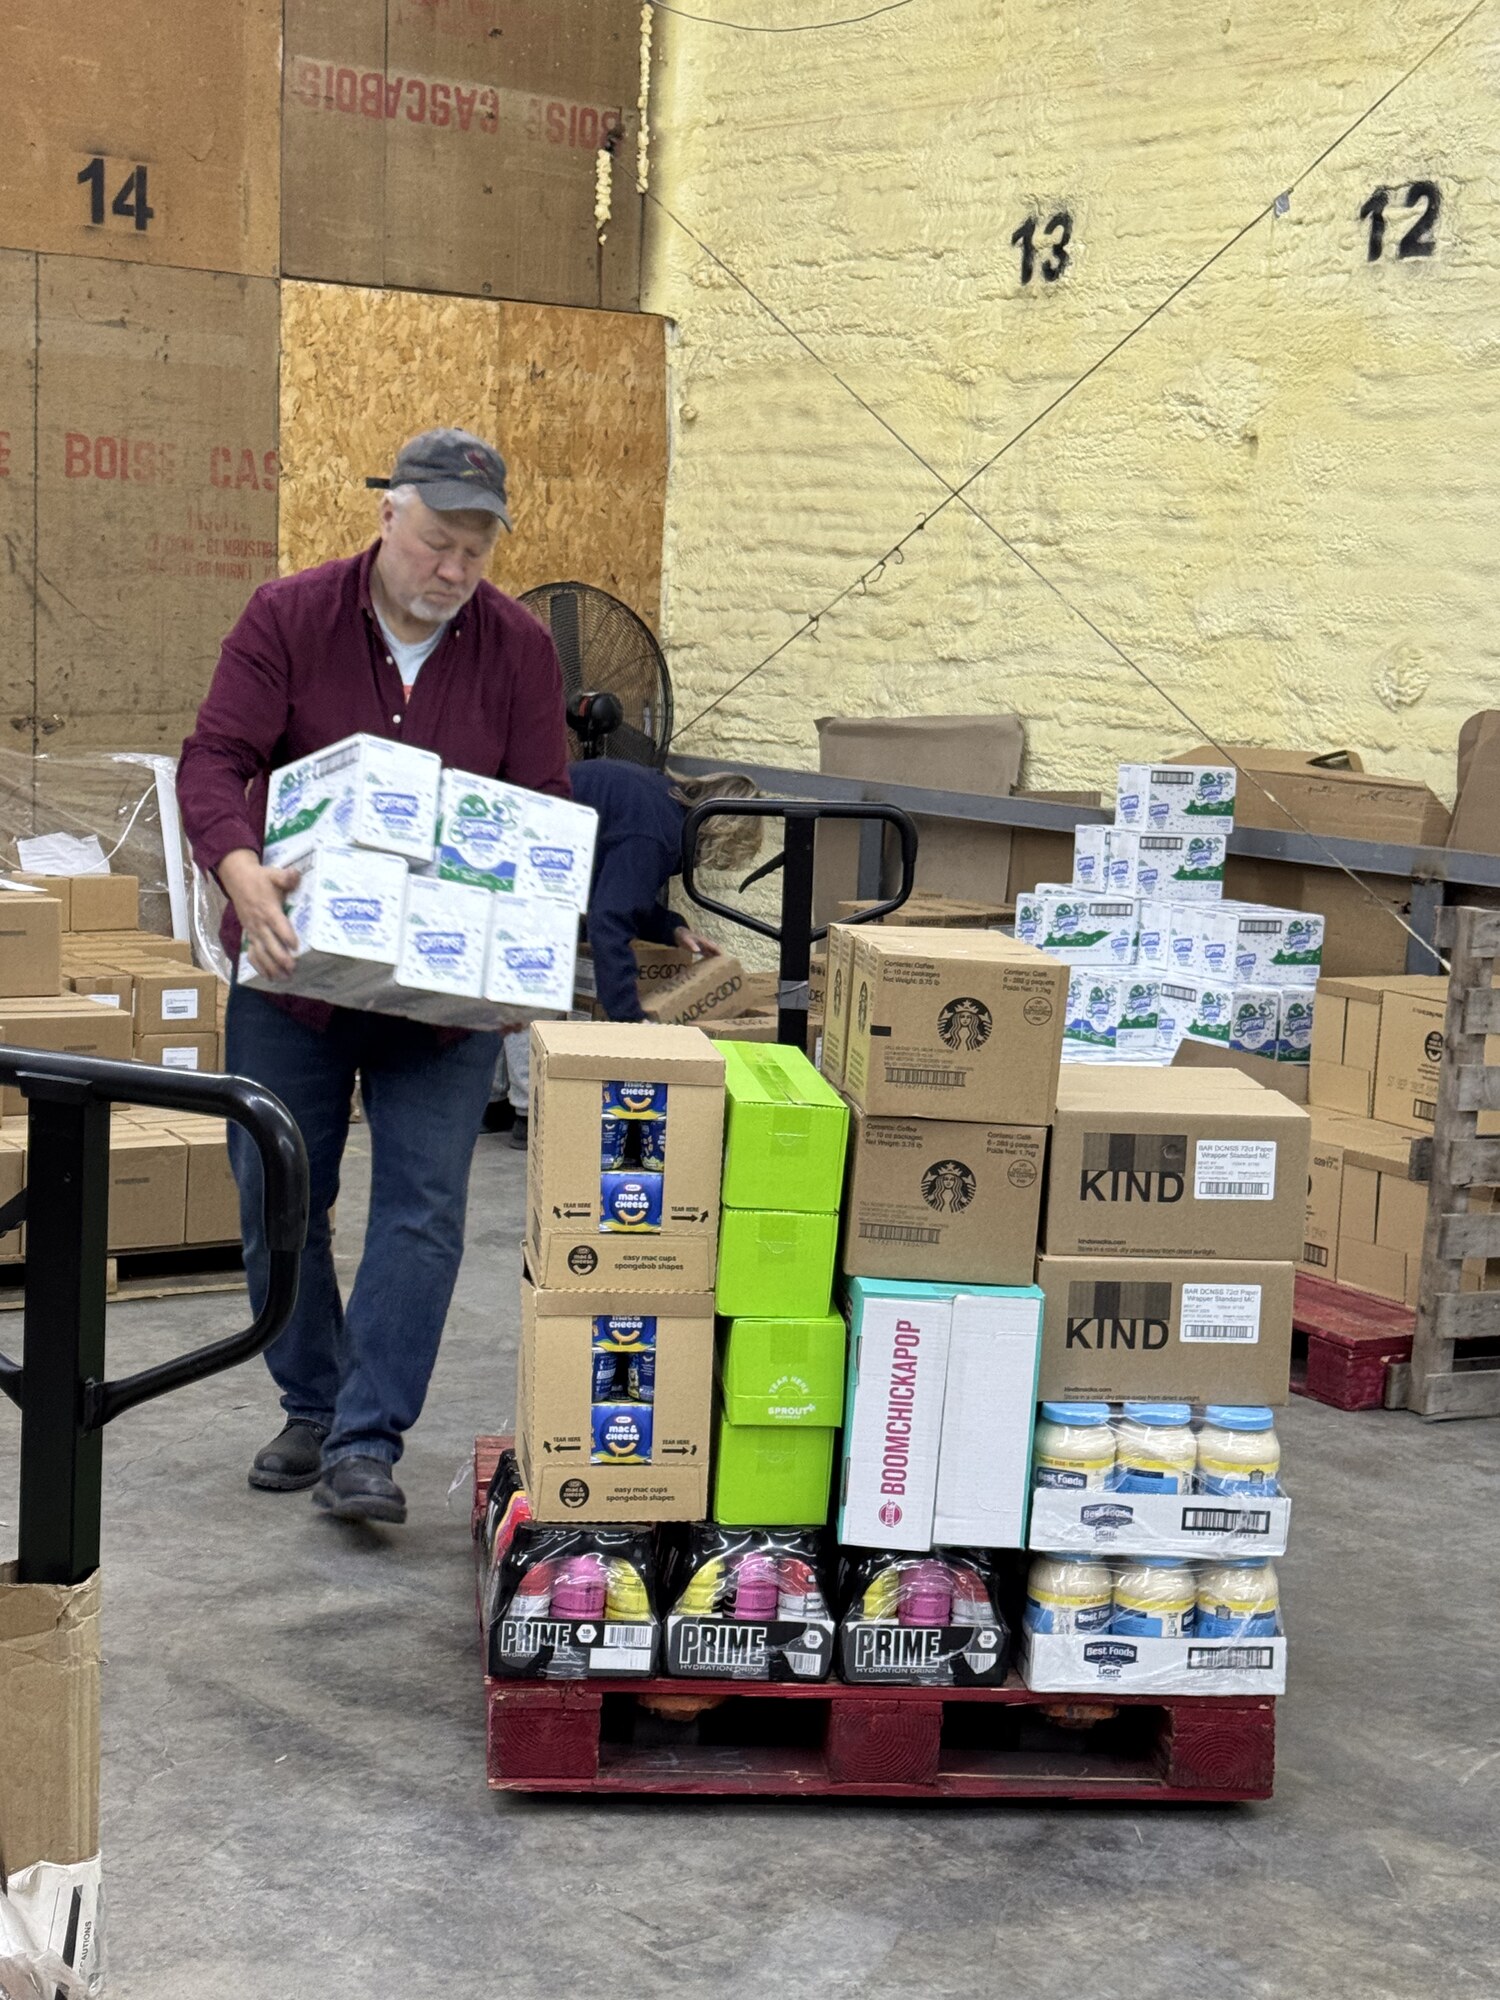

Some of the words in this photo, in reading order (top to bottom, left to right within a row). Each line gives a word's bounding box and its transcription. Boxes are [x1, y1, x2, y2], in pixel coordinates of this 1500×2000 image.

[76, 157, 155, 232] 14
[1359, 179, 1442, 263] 12
[1011, 210, 1074, 287] 13
[618, 1193, 639, 1201] mac
[1080, 1170, 1185, 1203] KIND
[1066, 1317, 1170, 1350] KIND
[768, 1375, 788, 1394] TEAR
[790, 1376, 811, 1395] HERE
[768, 1406, 807, 1415] SPROUT
[880, 1319, 921, 1496] BOOMCHICKAPOP
[608, 1424, 628, 1433] mac
[606, 1494, 648, 1502] spongebob
[648, 1494, 676, 1502] shapes
[614, 1486, 631, 1494] easy
[650, 1486, 668, 1494] cups
[1098, 1610, 1111, 1620] Foo
[501, 1620, 572, 1655] PRIME
[679, 1624, 767, 1667] PRIME
[855, 1628, 942, 1668] PRIME
[1086, 1646, 1108, 1656] Best
[1108, 1646, 1135, 1658] Foods
[680, 1664, 732, 1672] HYDRATION
